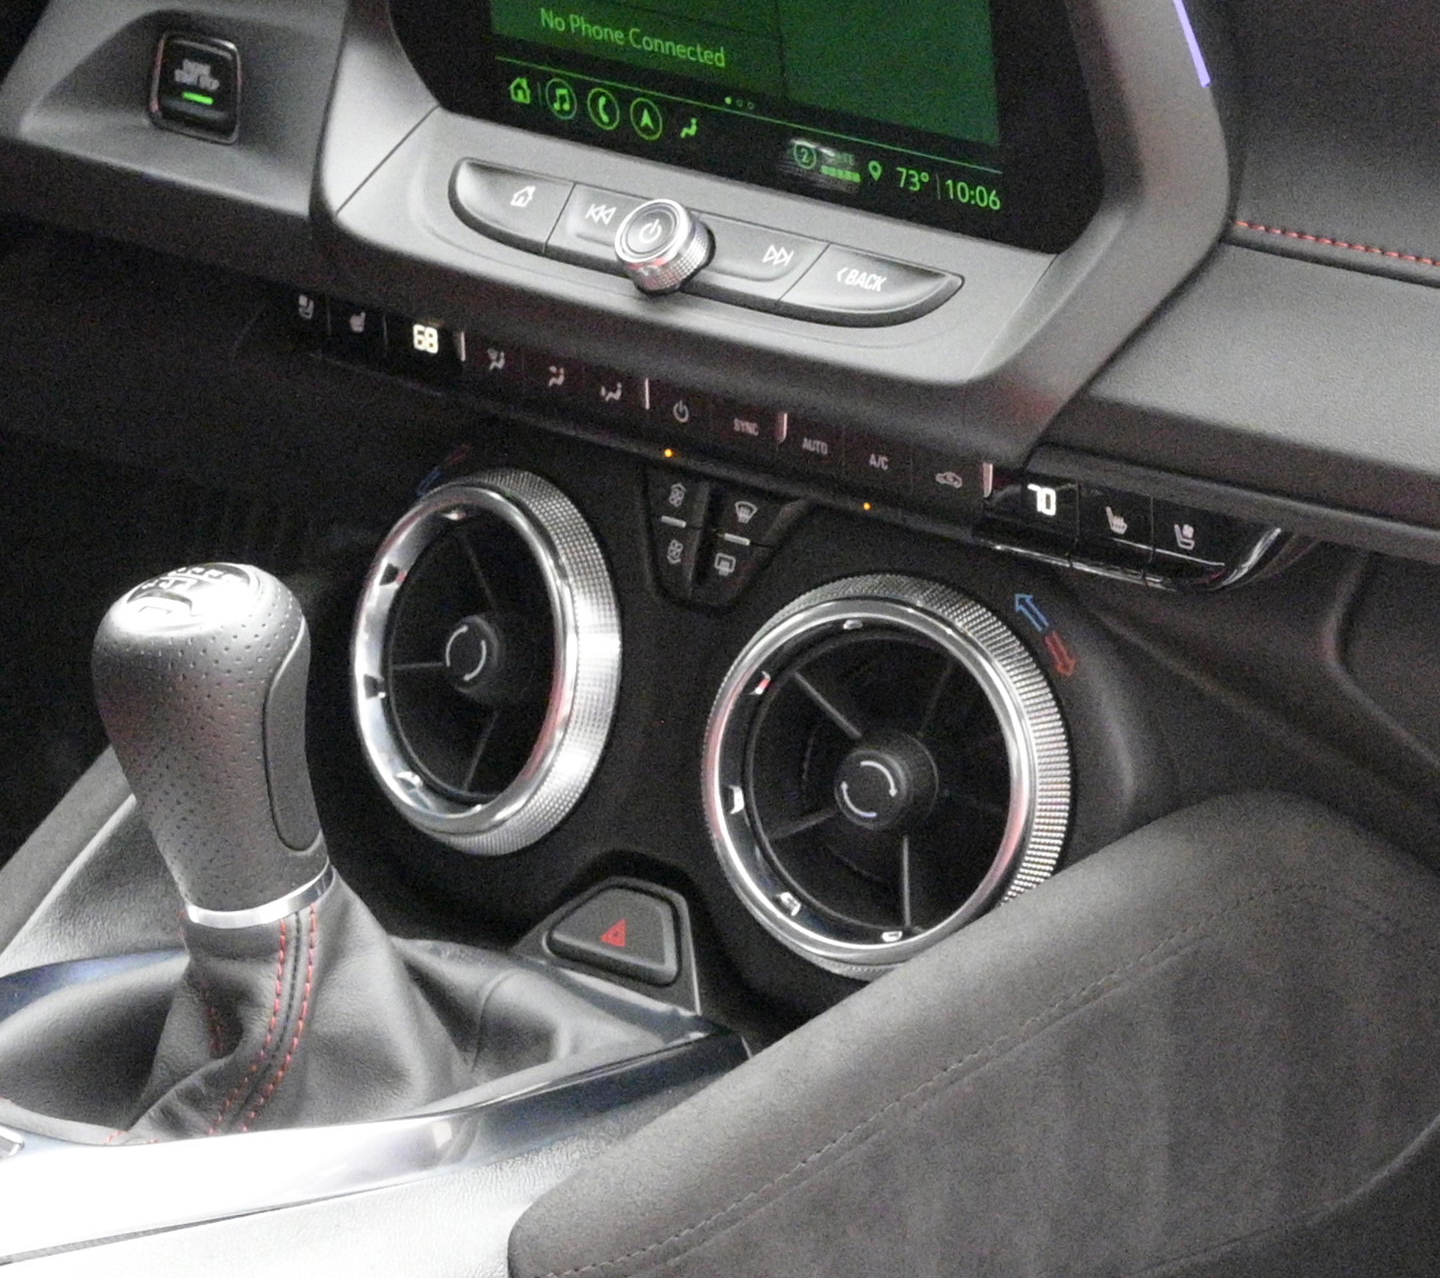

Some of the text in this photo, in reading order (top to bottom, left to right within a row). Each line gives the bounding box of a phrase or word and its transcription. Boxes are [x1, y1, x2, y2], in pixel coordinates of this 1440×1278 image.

[540, 7, 726, 68] No Phone Connected
[945, 179, 1001, 211] 10:06
[845, 268, 887, 292] BACK
[412, 323, 439, 354] 68
[733, 418, 759, 436] SYNC
[802, 436, 828, 455] AUTO
[869, 453, 889, 471] A/C
